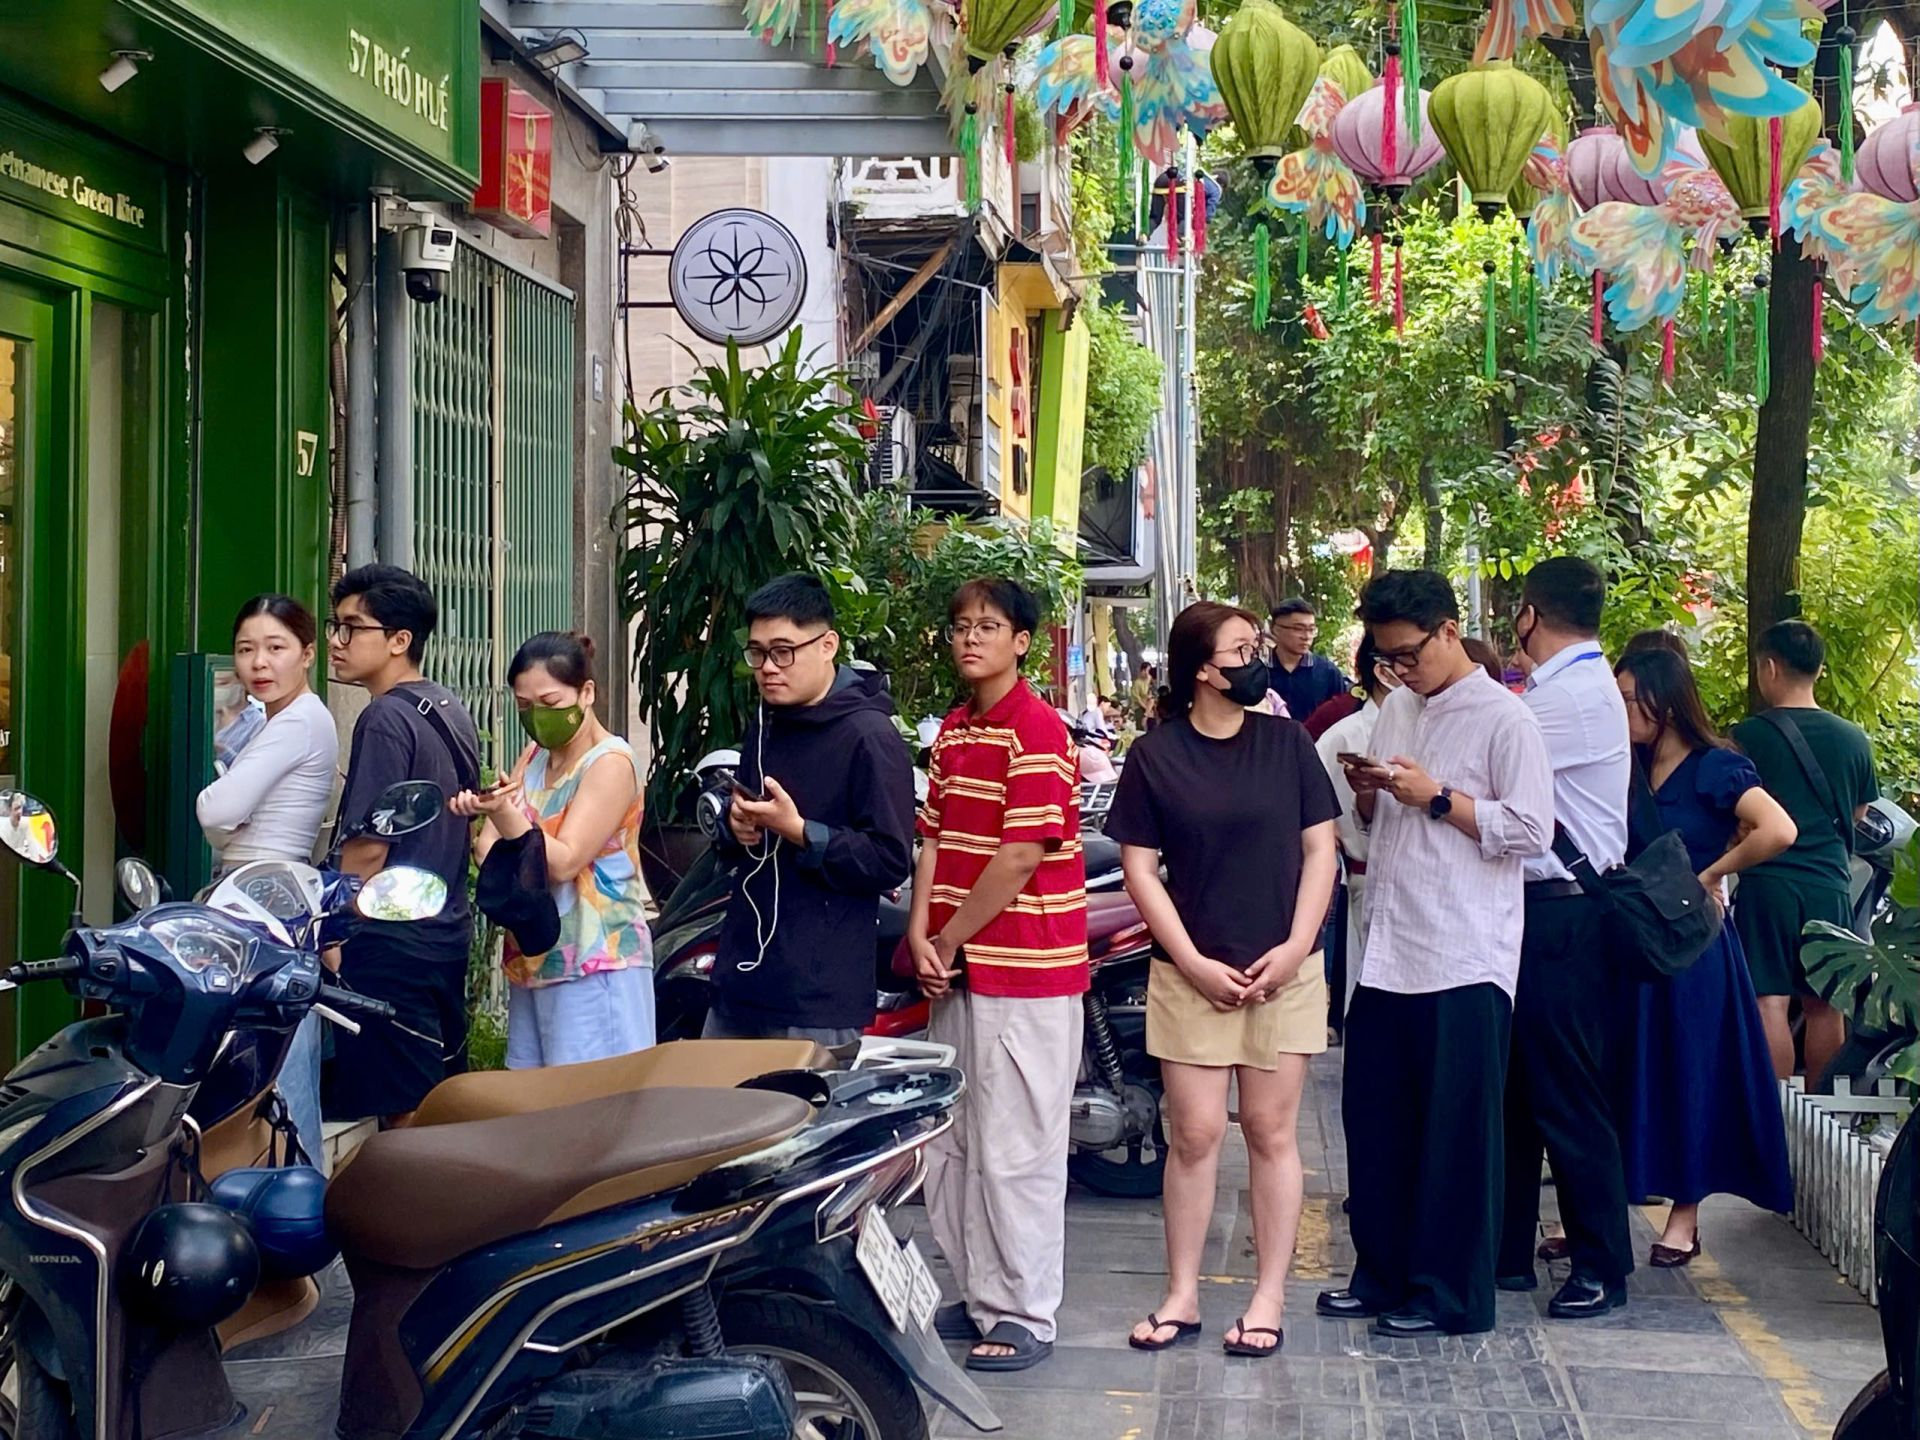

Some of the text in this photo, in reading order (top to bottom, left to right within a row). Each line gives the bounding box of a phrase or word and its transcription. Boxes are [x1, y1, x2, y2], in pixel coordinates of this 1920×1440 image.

[348, 28, 370, 78] 57
[72, 175, 114, 217] Green
[116, 193, 144, 228] Rice
[296, 430, 318, 477] 57
[28, 1254, 82, 1264] HONDA
